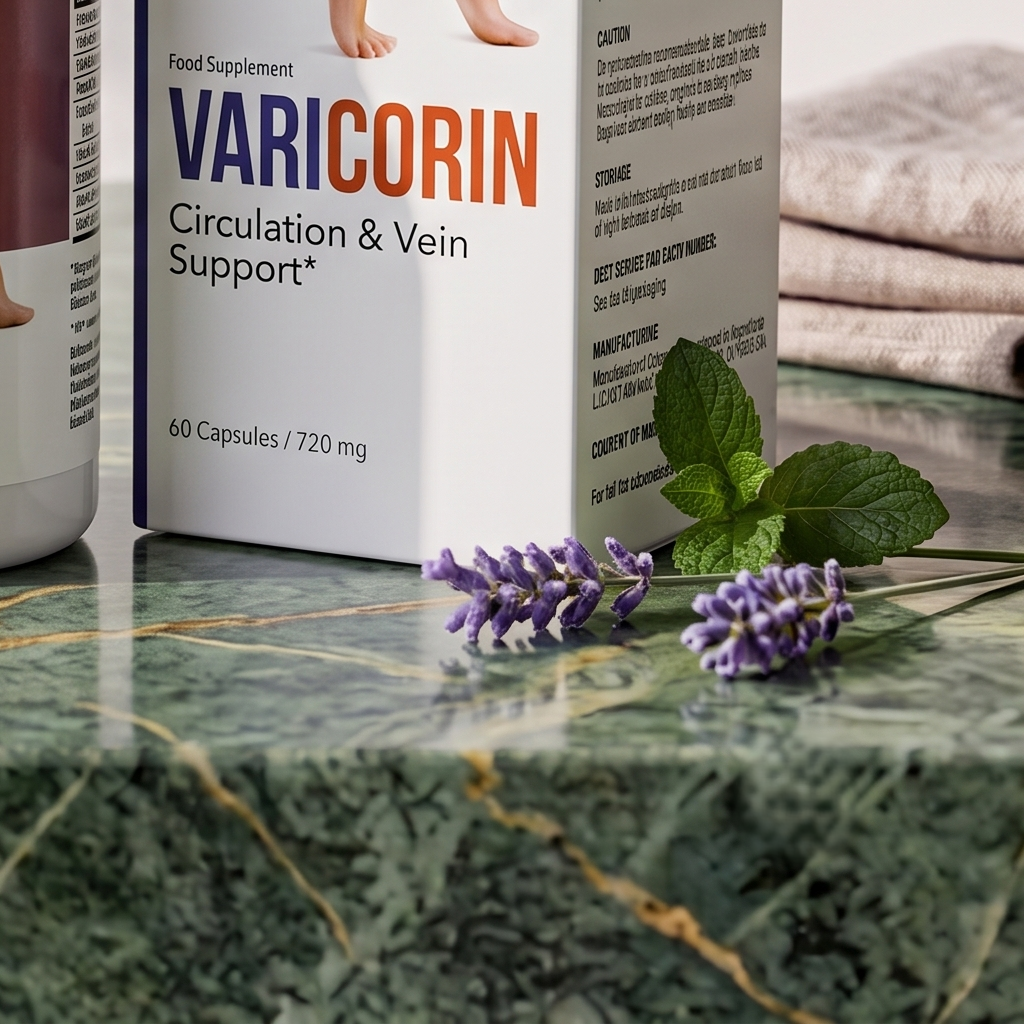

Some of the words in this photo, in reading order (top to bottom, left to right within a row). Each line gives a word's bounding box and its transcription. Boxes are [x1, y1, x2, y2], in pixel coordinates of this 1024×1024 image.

[597, 24, 631, 48] CAUTION
[169, 54, 203, 72] Food
[207, 55, 294, 78] Supplement
[168, 87, 538, 208] VARICORIN
[169, 202, 346, 248] Circulation
[358, 218, 384, 251] &
[394, 221, 468, 259] Vein
[169, 418, 192, 438] 60
[197, 420, 279, 449] Capsules
[283, 430, 292, 450] /
[296, 432, 332, 454] 720
[338, 440, 367, 464] mg
[630, 426, 640, 445] OF
